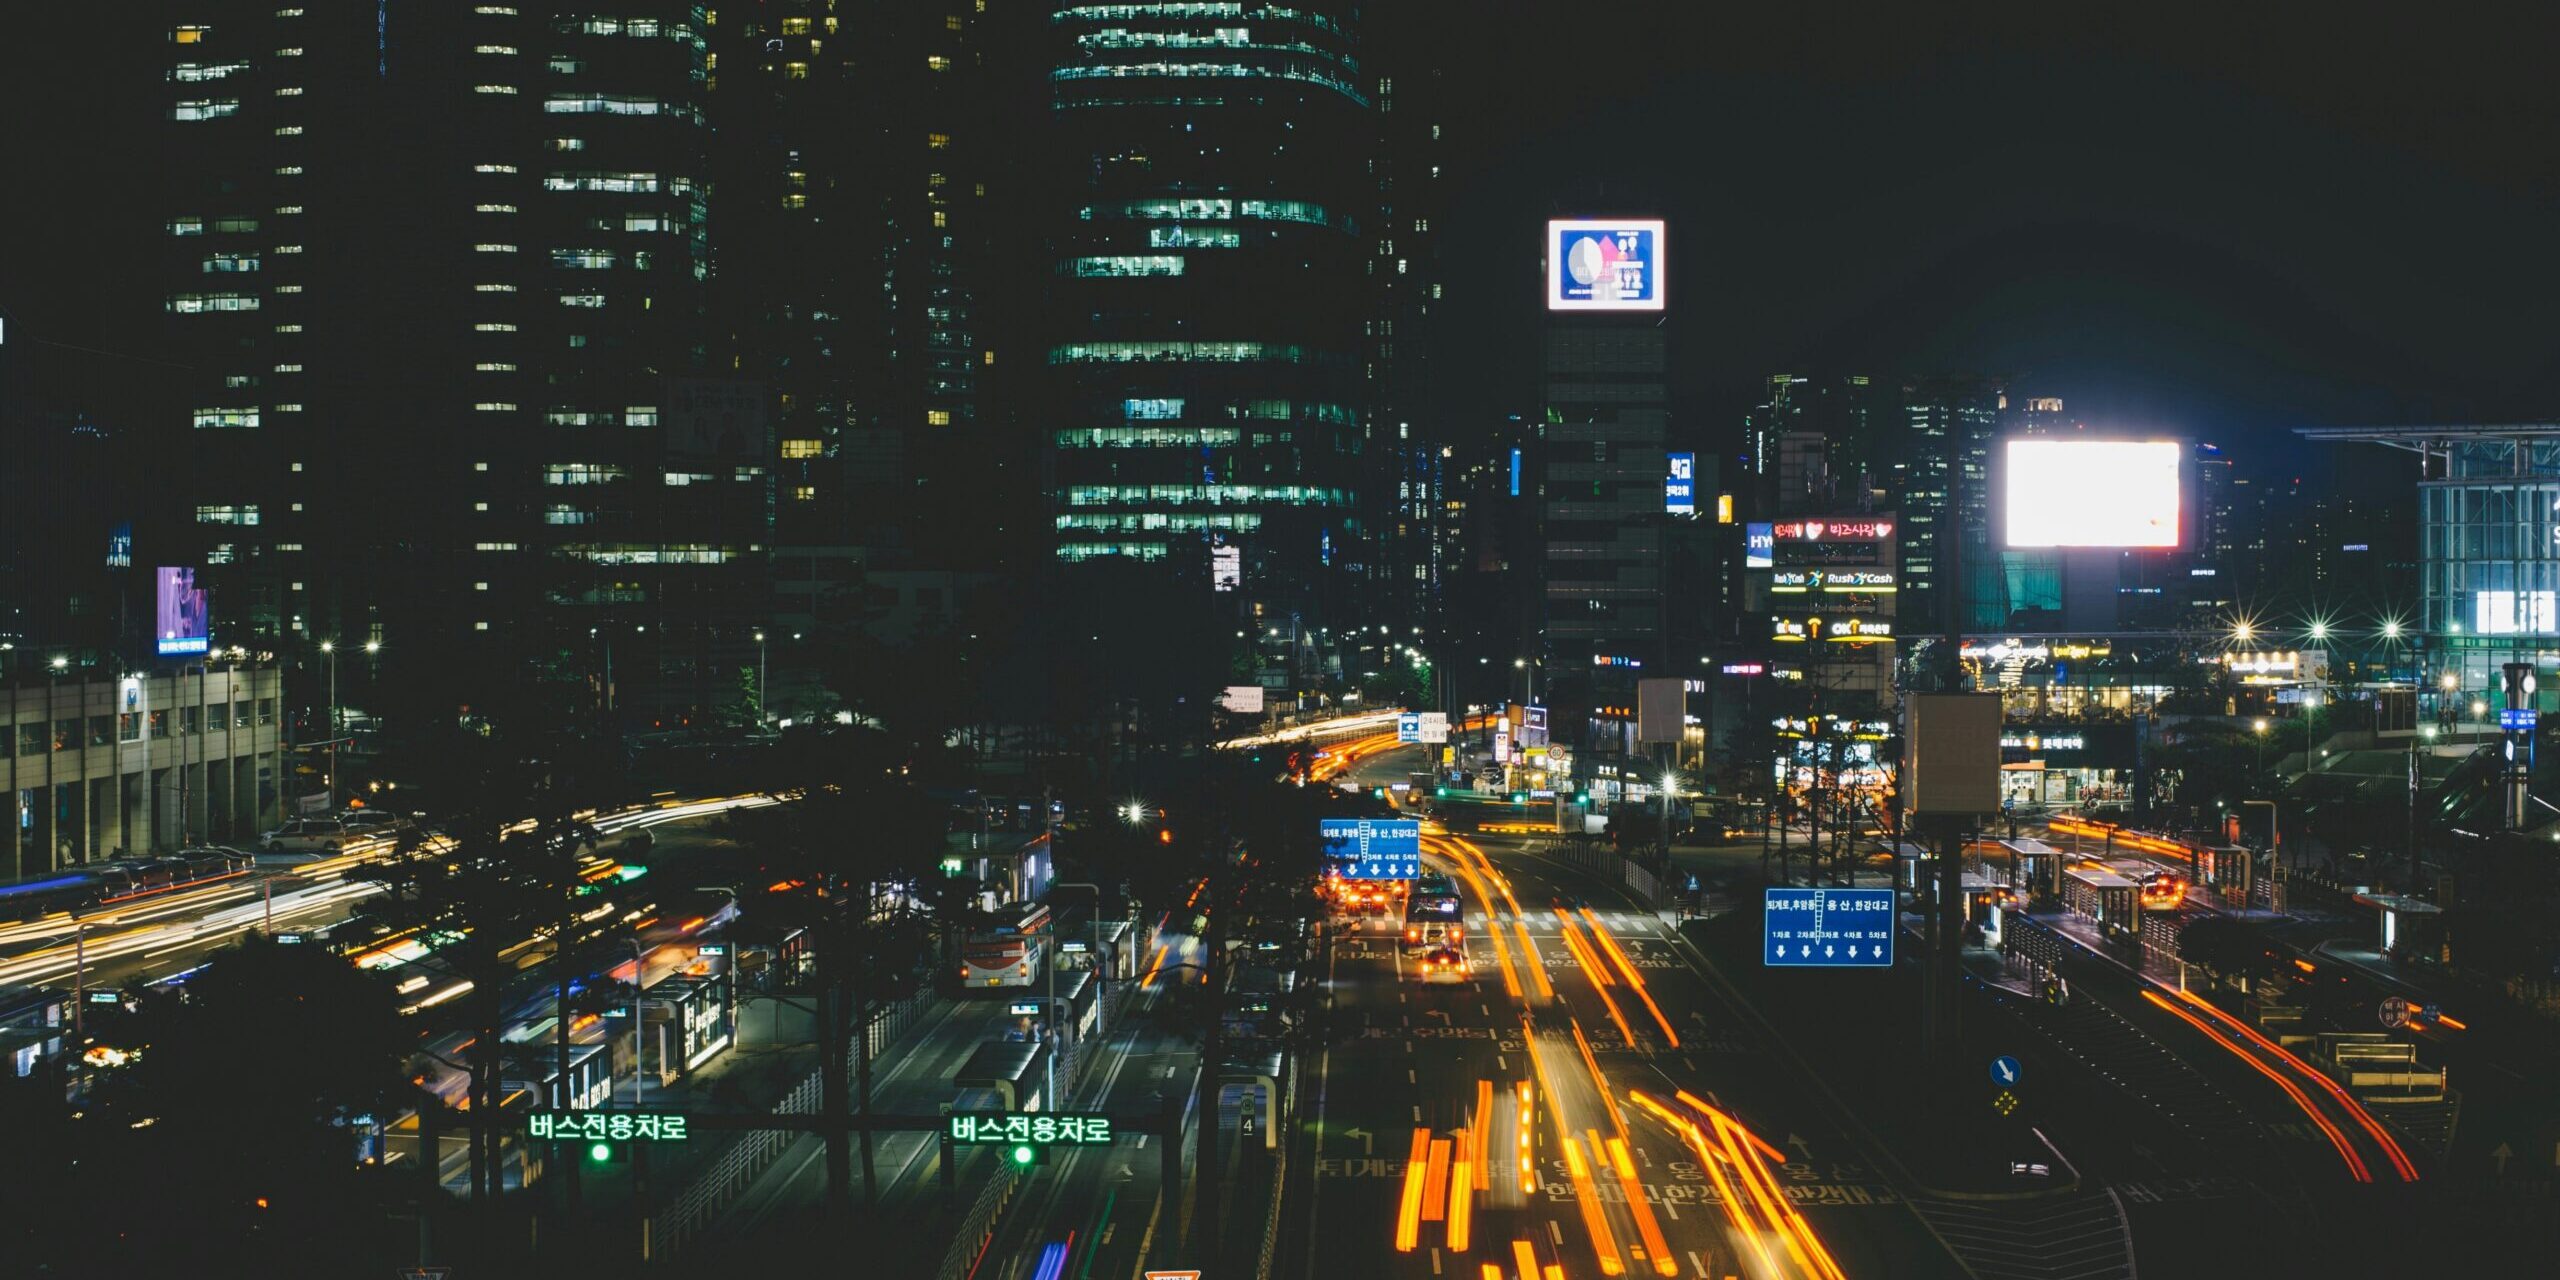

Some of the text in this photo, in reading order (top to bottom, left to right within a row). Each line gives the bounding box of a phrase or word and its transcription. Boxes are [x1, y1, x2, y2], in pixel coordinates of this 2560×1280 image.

[1830, 523, 1875, 536] 미즈사랑
[1828, 573, 1893, 584] Rush Cash
[1832, 623, 1851, 635] OK
[1772, 931, 1888, 939] 1차로 2차로 3차로 4차로 5차로
[530, 1114, 687, 1140] 버스전용차로
[952, 1116, 1111, 1142] 버스전용차로
[1243, 1119, 1253, 1132] 4
